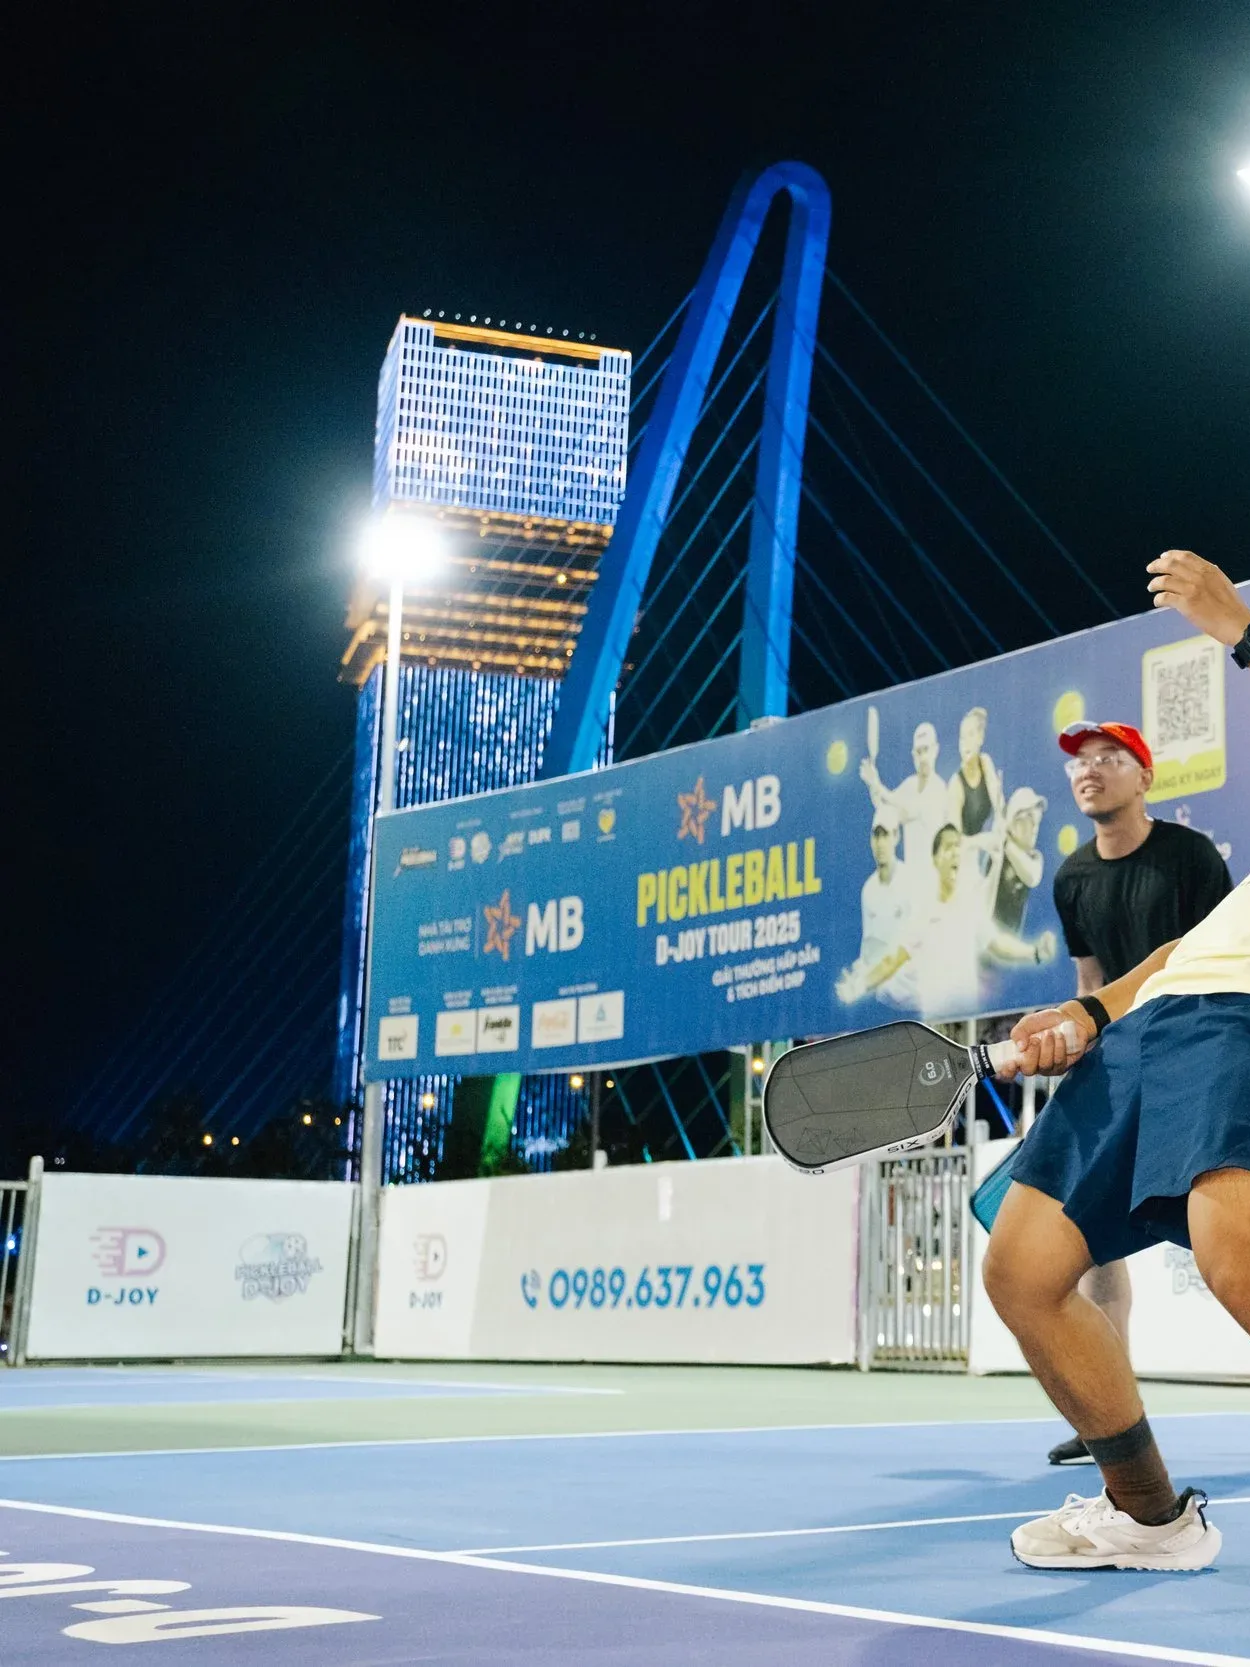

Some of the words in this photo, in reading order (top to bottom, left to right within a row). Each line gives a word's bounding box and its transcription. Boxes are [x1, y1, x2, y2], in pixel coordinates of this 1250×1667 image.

[721, 774, 781, 837] MB
[637, 837, 822, 927] PICKLEBALL
[525, 895, 584, 956] MB
[656, 927, 707, 966] D-JOY
[708, 919, 751, 956] TOUR
[754, 910, 800, 948] 2025
[887, 1139, 920, 1153] SIX
[87, 1287, 159, 1306] D-JOY
[409, 1292, 443, 1310] D-JOY
[548, 1262, 766, 1310] 0989.637.963
